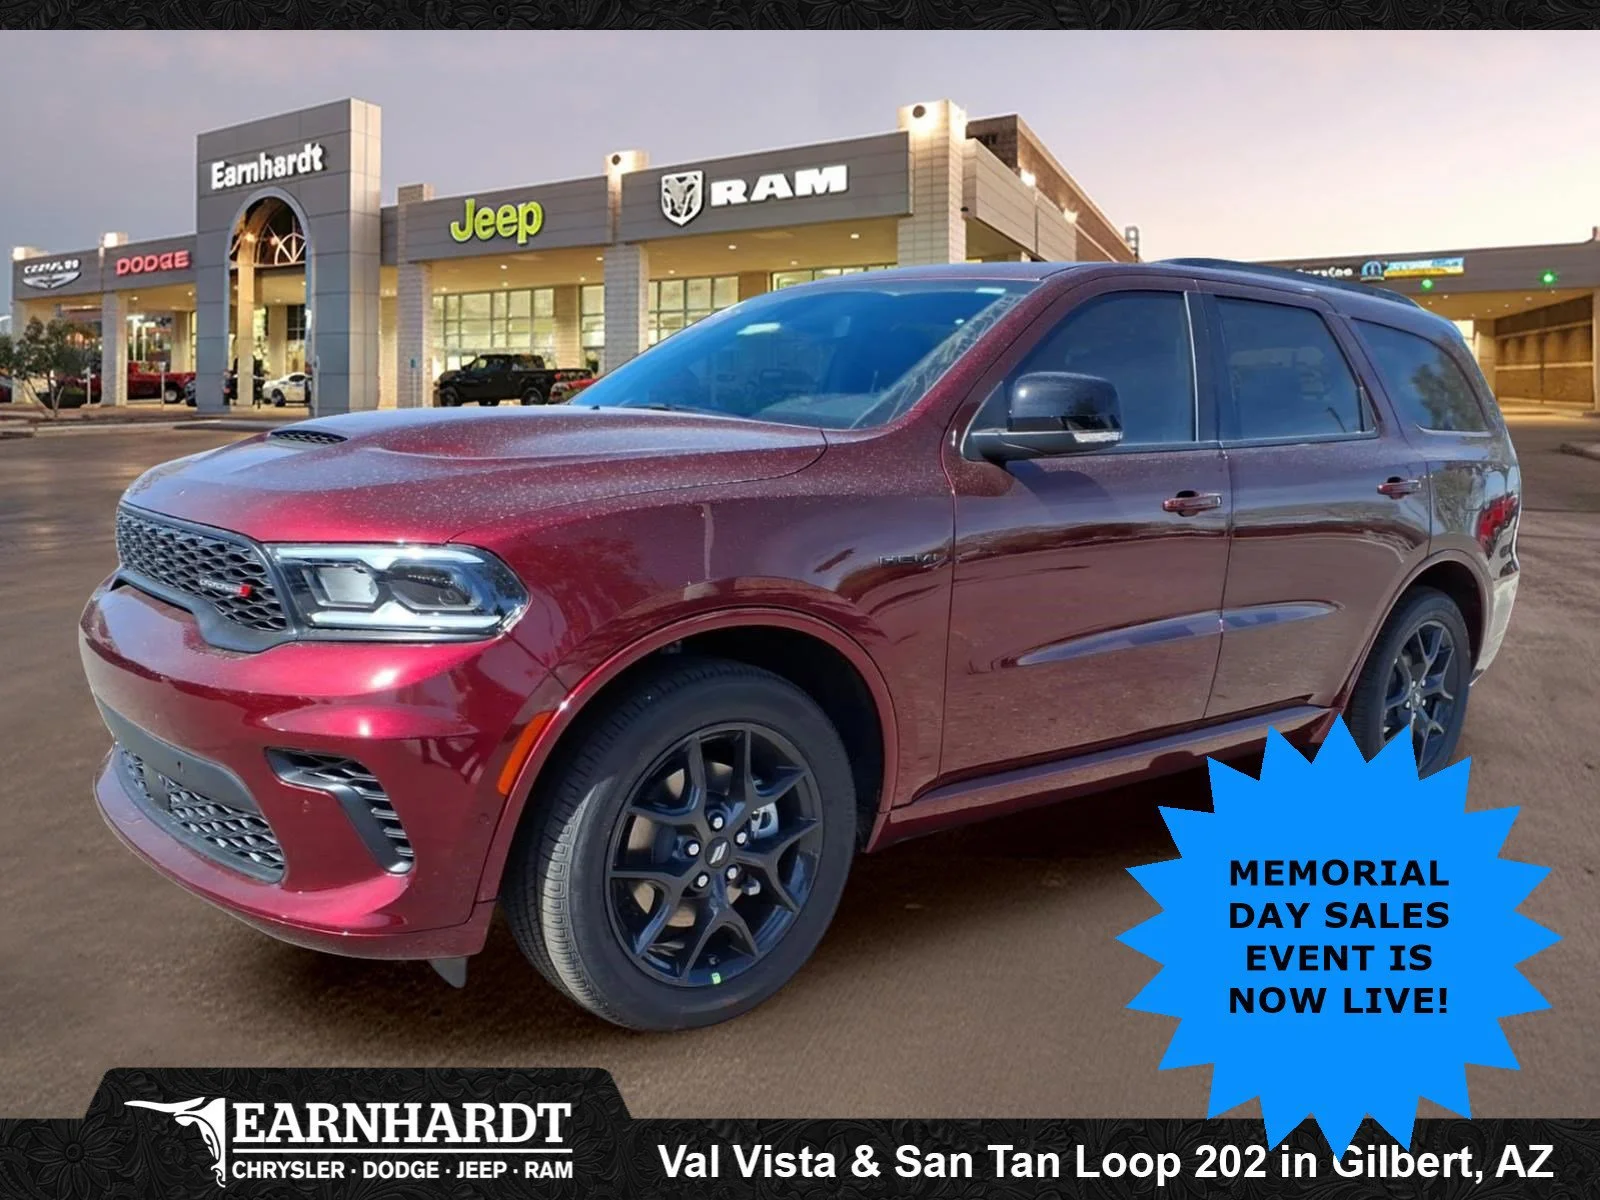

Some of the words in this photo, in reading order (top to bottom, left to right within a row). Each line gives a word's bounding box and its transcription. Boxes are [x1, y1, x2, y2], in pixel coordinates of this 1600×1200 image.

[211, 143, 323, 190] Earnhardt
[710, 165, 847, 207] RAM
[450, 199, 545, 244] Jeep
[116, 250, 190, 276] DODGE
